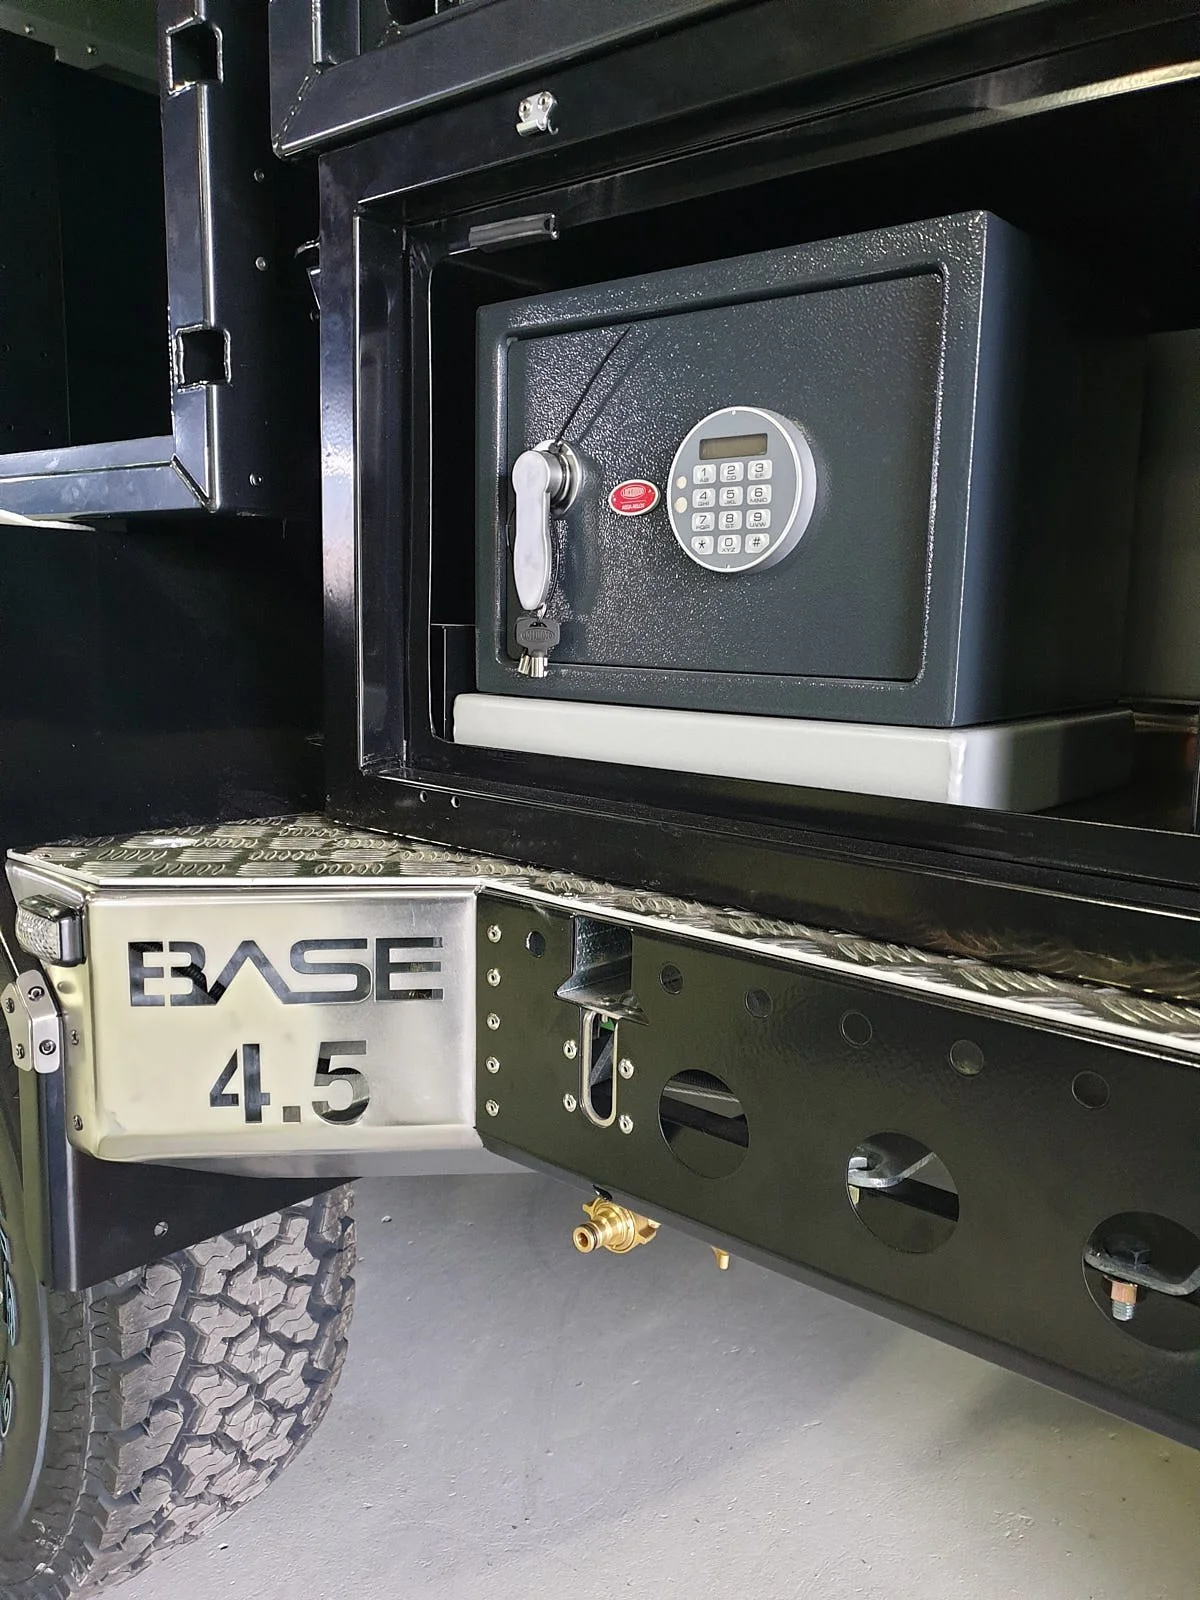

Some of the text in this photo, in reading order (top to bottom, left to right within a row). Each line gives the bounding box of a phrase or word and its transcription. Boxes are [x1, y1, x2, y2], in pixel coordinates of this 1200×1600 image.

[701, 467, 706, 476] 1
[727, 465, 736, 475] 2
[755, 463, 764, 473] 3
[699, 491, 707, 500] 4
[726, 489, 735, 499] 5
[754, 487, 763, 497] 6
[699, 515, 707, 524] 7
[725, 513, 734, 523] 8
[753, 512, 762, 522] 9
[724, 537, 733, 547] 0
[128, 937, 443, 1006] BASE
[210, 1040, 370, 1126] 4.5
